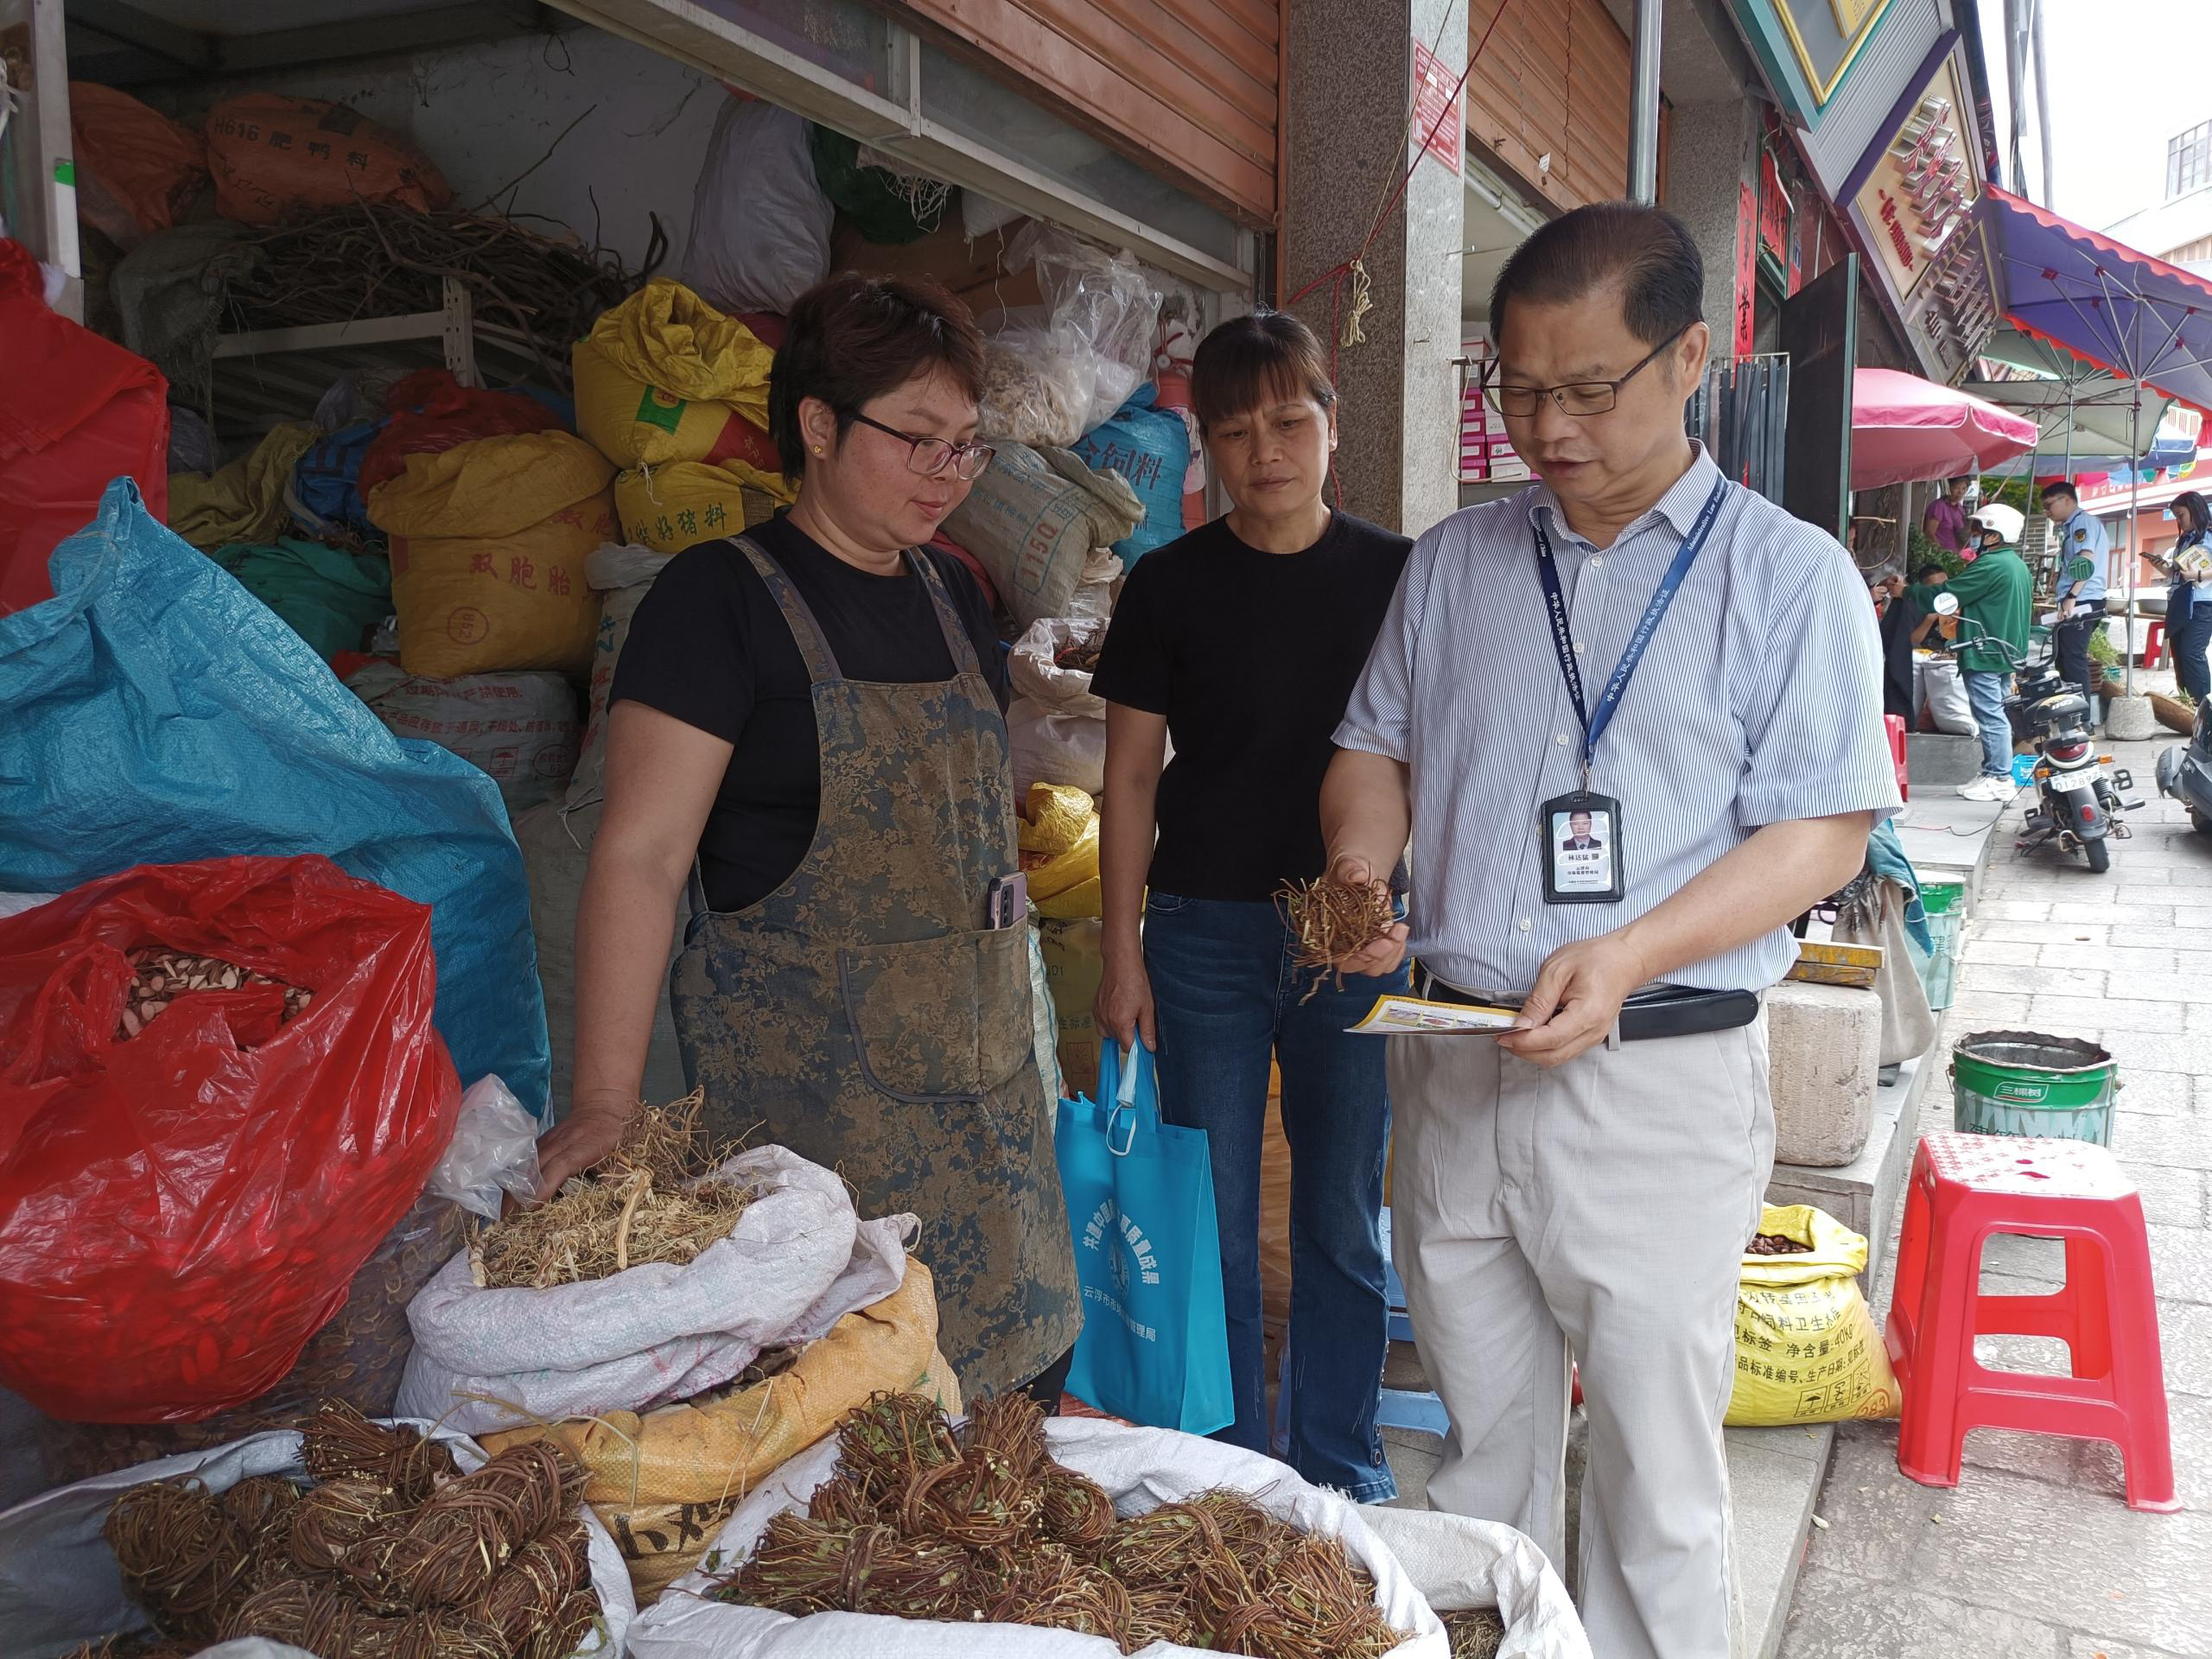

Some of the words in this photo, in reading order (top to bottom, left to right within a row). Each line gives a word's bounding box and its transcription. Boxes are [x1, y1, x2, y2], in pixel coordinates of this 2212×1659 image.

[1707, 502, 1717, 515] Law
[469, 552, 571, 596] 双胞胎
[1550, 592, 1582, 702] 中华人民共和国行政执法证
[1605, 588, 1671, 702] 中华人民共和国行政执法证
